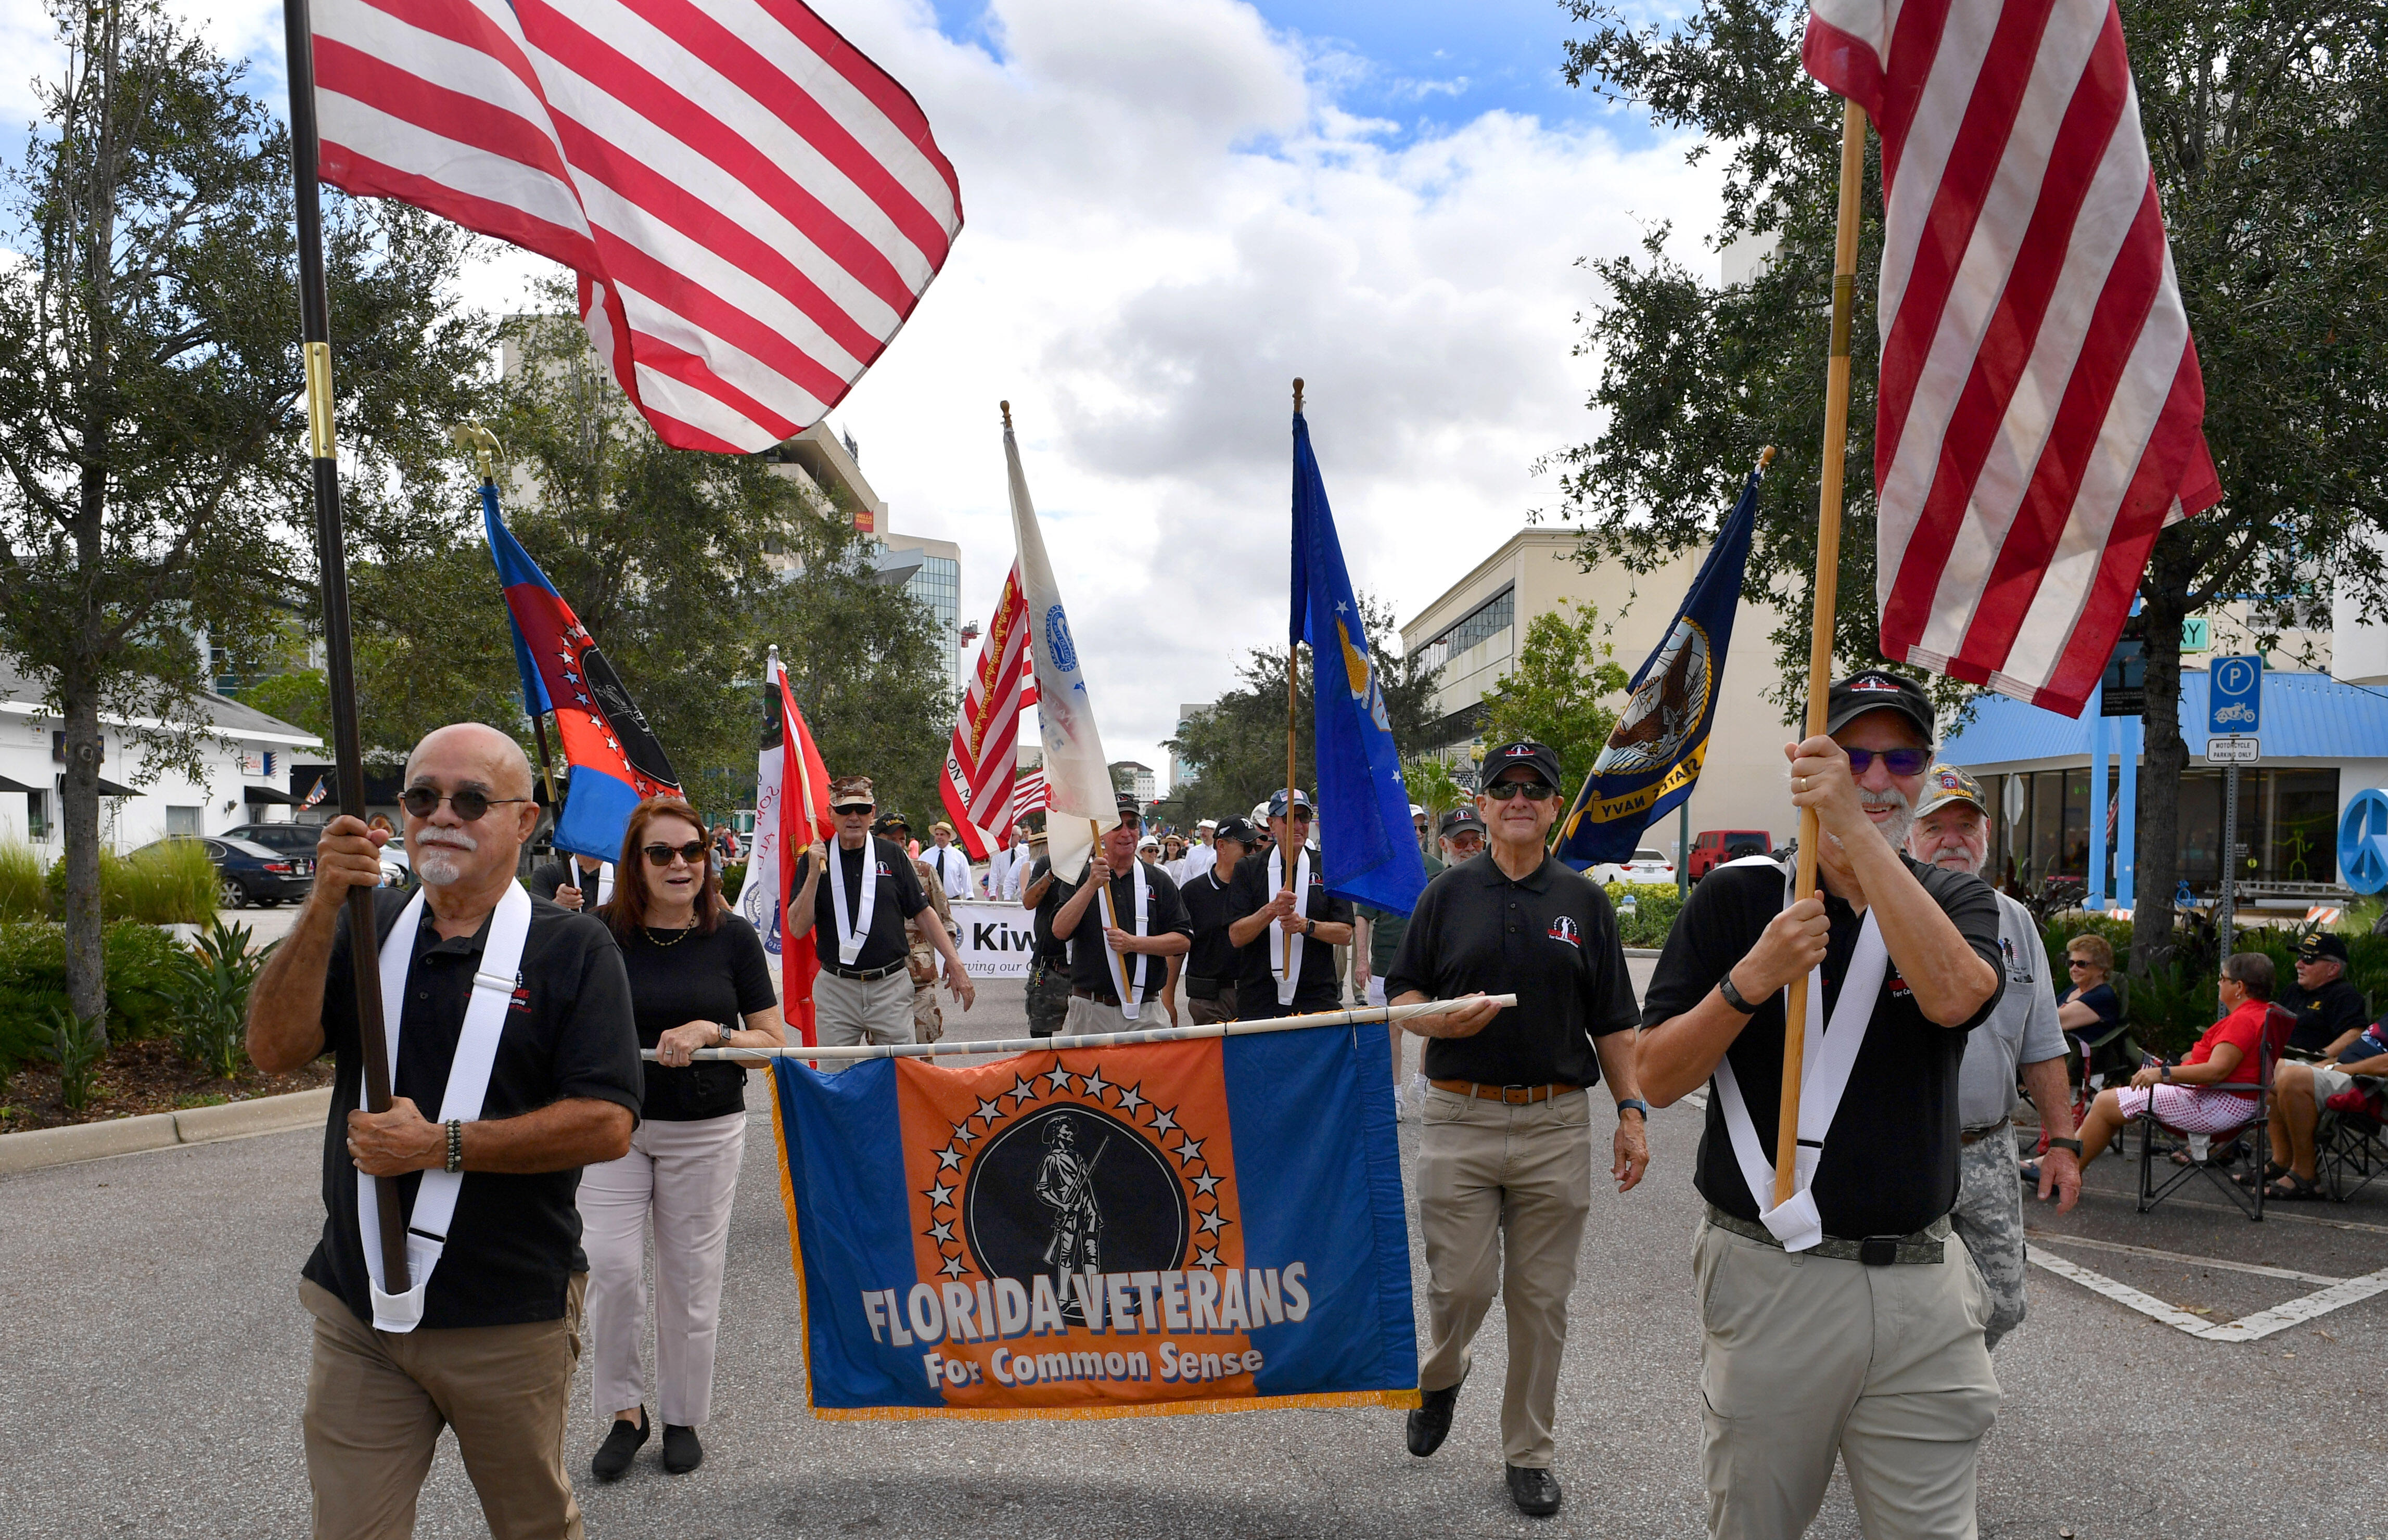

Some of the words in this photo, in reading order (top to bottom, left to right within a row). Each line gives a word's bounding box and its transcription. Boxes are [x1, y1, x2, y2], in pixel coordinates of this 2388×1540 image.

[2230, 668, 2241, 687] P
[948, 759, 964, 781] ON
[960, 788, 971, 808] M
[1933, 789, 1973, 799] DIVISION
[1000, 963, 1022, 971] our
[861, 1274, 1068, 1346] FLORIDA
[1071, 1261, 1310, 1334] VETERANS
[923, 1352, 982, 1388] For
[991, 1347, 1151, 1387] Common
[1159, 1341, 1264, 1383] Sense
